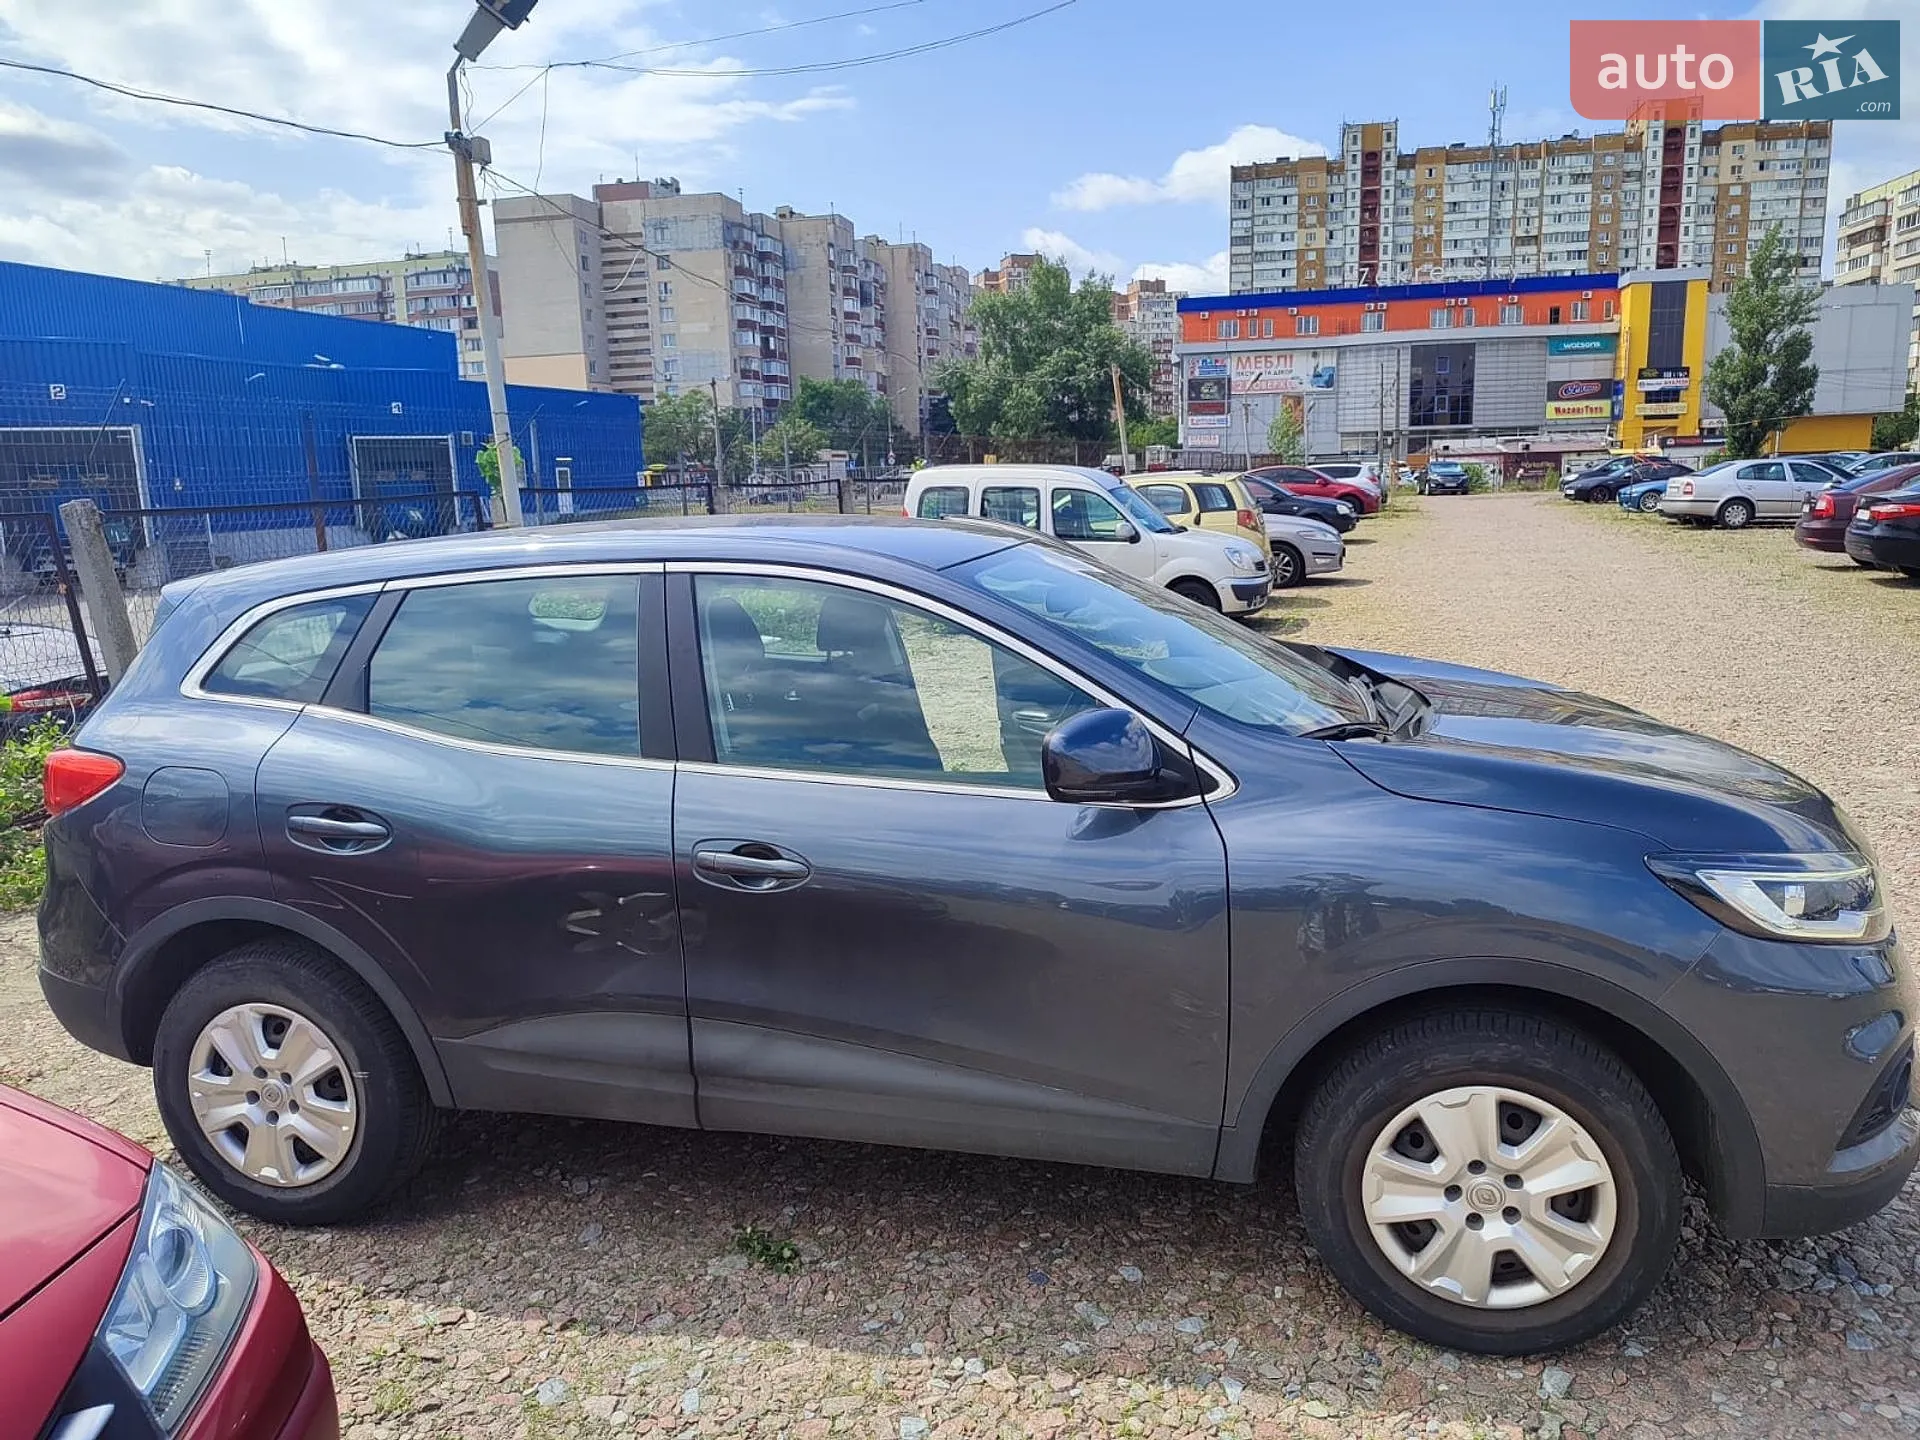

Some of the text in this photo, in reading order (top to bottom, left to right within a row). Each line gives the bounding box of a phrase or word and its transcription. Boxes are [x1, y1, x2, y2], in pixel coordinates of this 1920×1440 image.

[1563, 341, 1601, 350] watsons
[1236, 354, 1293, 370] МЕБЛІ
[52, 386, 65, 398] 2
